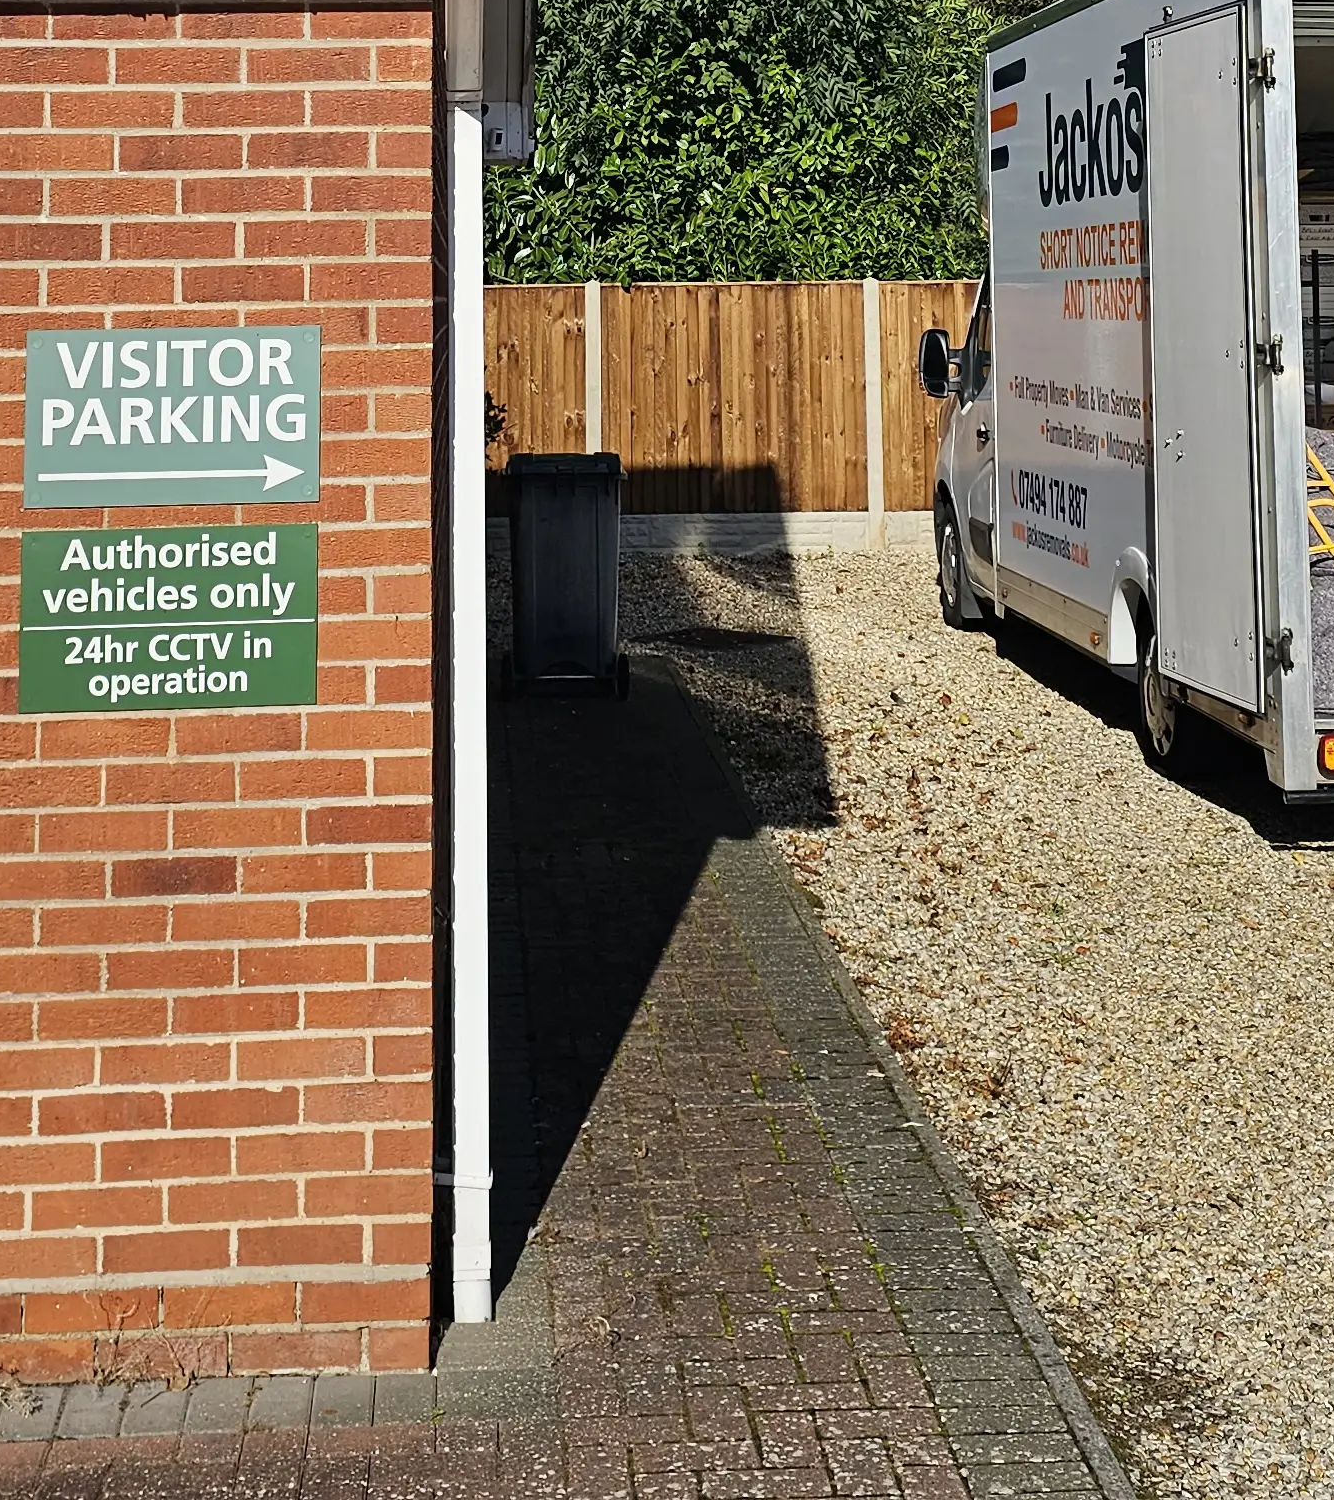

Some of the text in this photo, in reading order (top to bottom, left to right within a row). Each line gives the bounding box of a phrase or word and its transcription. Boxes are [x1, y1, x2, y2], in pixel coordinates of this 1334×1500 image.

[1039, 78, 1144, 208] Jackos
[1040, 229, 1073, 270] SHORT
[1076, 224, 1116, 268] NOTICE
[1063, 280, 1086, 320] AND
[56, 338, 294, 389] VISITOR
[41, 393, 307, 447] PARKING
[1014, 375, 1025, 400] Full
[1026, 377, 1048, 409] Property
[1049, 380, 1069, 407] Moves
[1075, 383, 1089, 410] Man
[1090, 386, 1096, 411] &
[1096, 386, 1110, 413] Van
[1111, 388, 1142, 420] Services
[1046, 418, 1072, 448] Furniture
[1074, 424, 1099, 460] Delivery
[1106, 431, 1146, 469] Motorcycle
[1019, 469, 1087, 530] 07494 174 887
[59, 531, 277, 571] Authorised
[42, 573, 296, 616] vehicles only
[64, 630, 272, 665] 24hr CCTV in
[88, 664, 248, 703] operation
